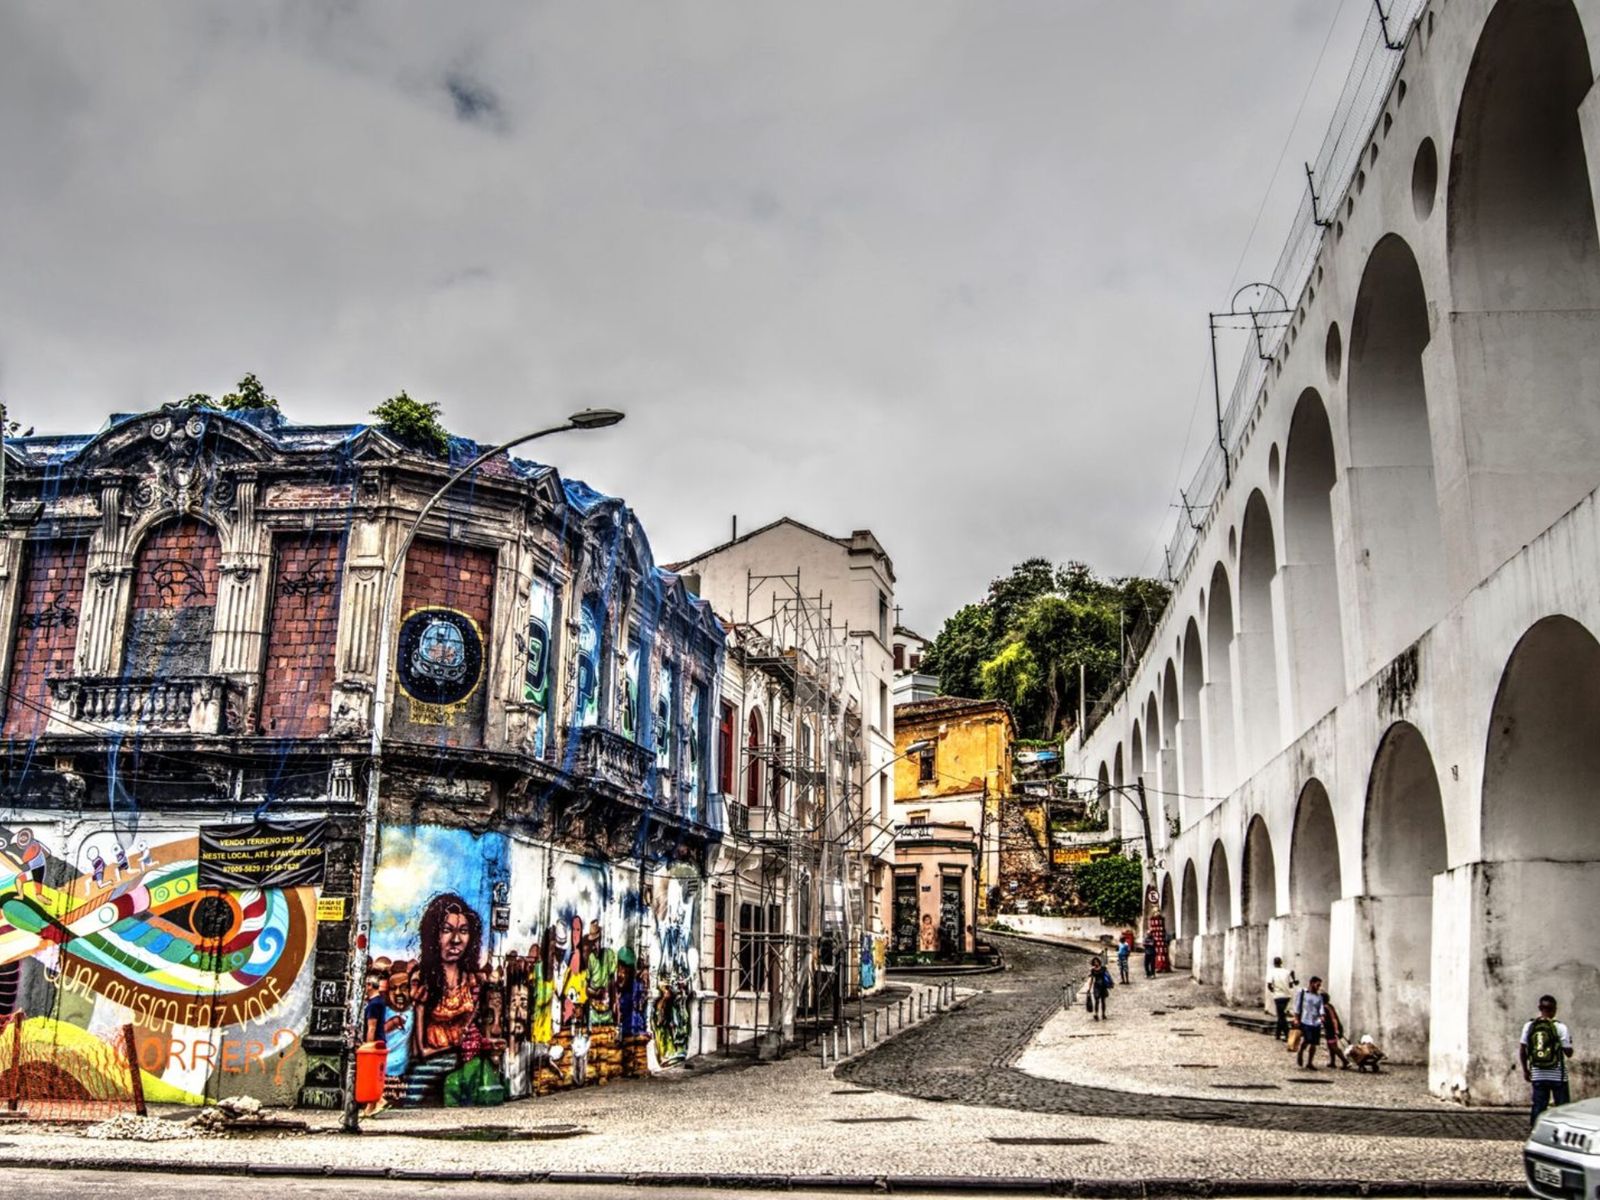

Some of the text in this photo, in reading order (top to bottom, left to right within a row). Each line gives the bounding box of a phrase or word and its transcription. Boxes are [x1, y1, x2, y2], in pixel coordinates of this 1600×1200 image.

[219, 838, 246, 846] VENDO
[247, 836, 281, 845] TERRENO
[202, 852, 226, 860] NESTE
[254, 849, 269, 859] ATÉ
[270, 850, 275, 858] 4
[275, 847, 322, 858] PAVIMENTOS
[43, 954, 100, 1005] QUAL
[103, 980, 179, 1034] MÚSICA
[182, 1002, 229, 1036] FAZ
[232, 976, 296, 1033] VOCÊ
